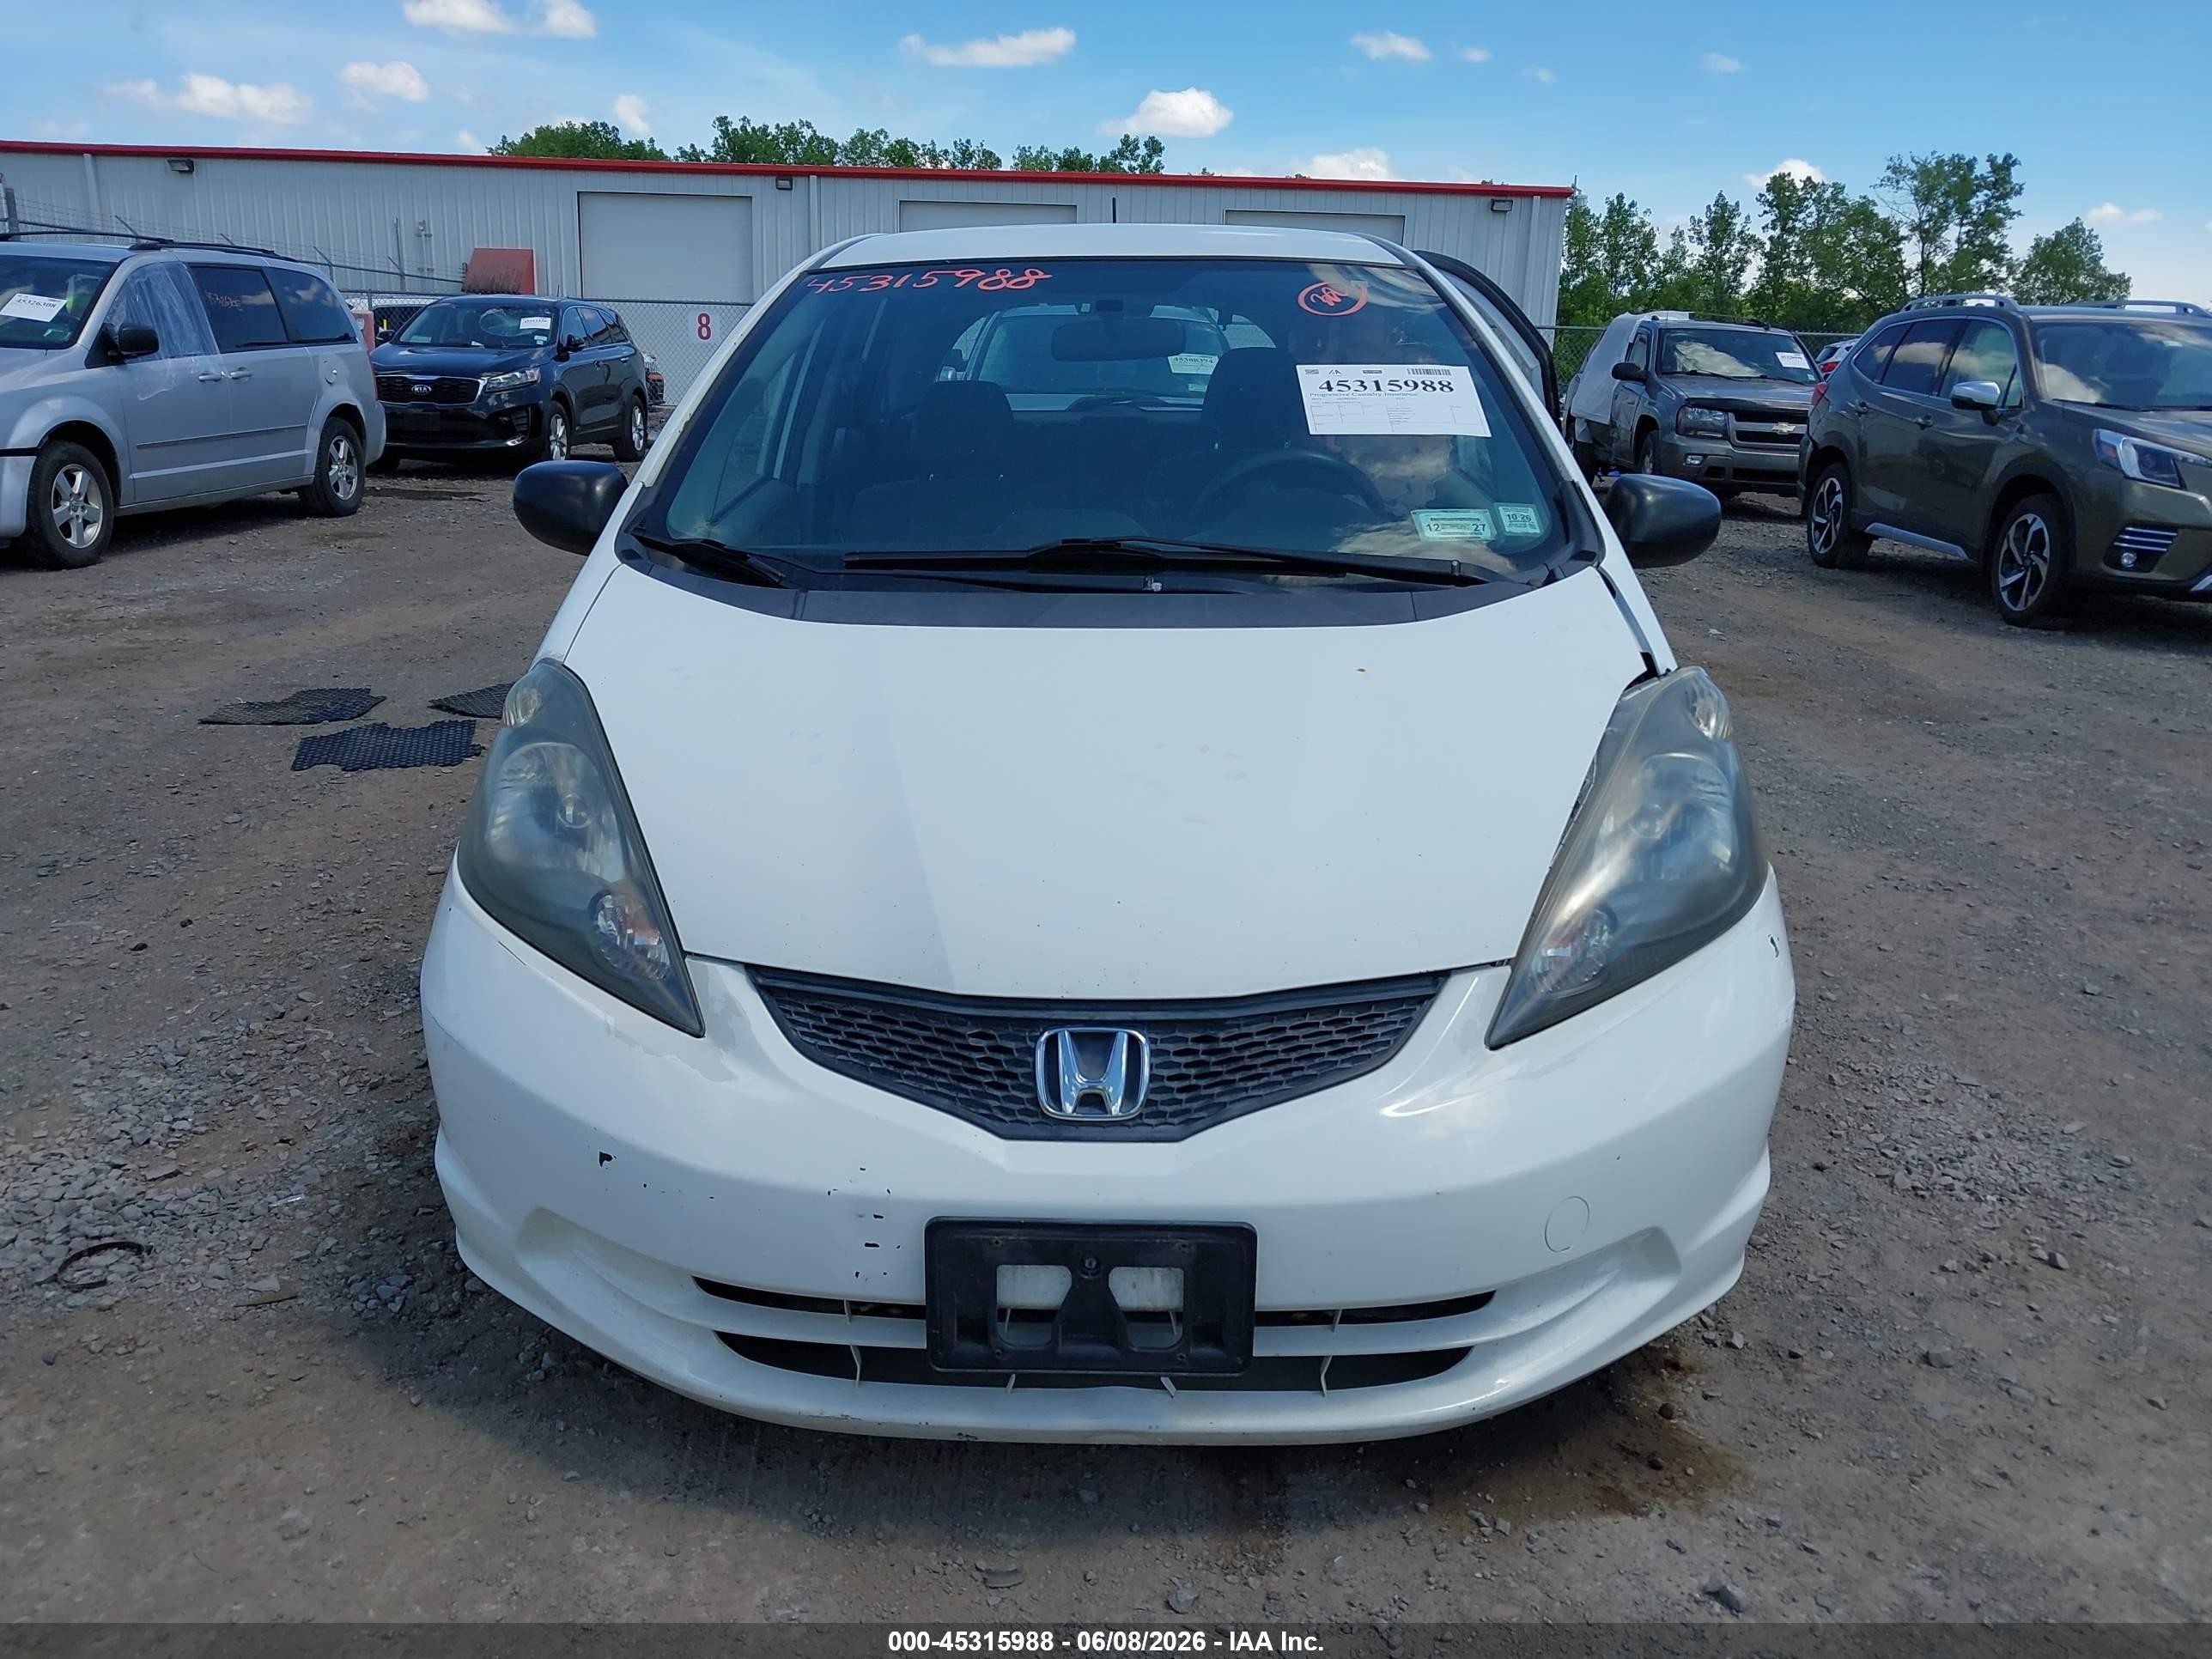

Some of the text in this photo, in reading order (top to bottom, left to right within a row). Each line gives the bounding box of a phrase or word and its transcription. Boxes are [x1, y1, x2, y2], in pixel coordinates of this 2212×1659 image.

[806, 269, 1054, 294] 45315988
[697, 313, 712, 341] 8
[1318, 379, 1455, 393] 45315988
[1425, 523, 1441, 532] 12
[1472, 523, 1486, 532] 27
